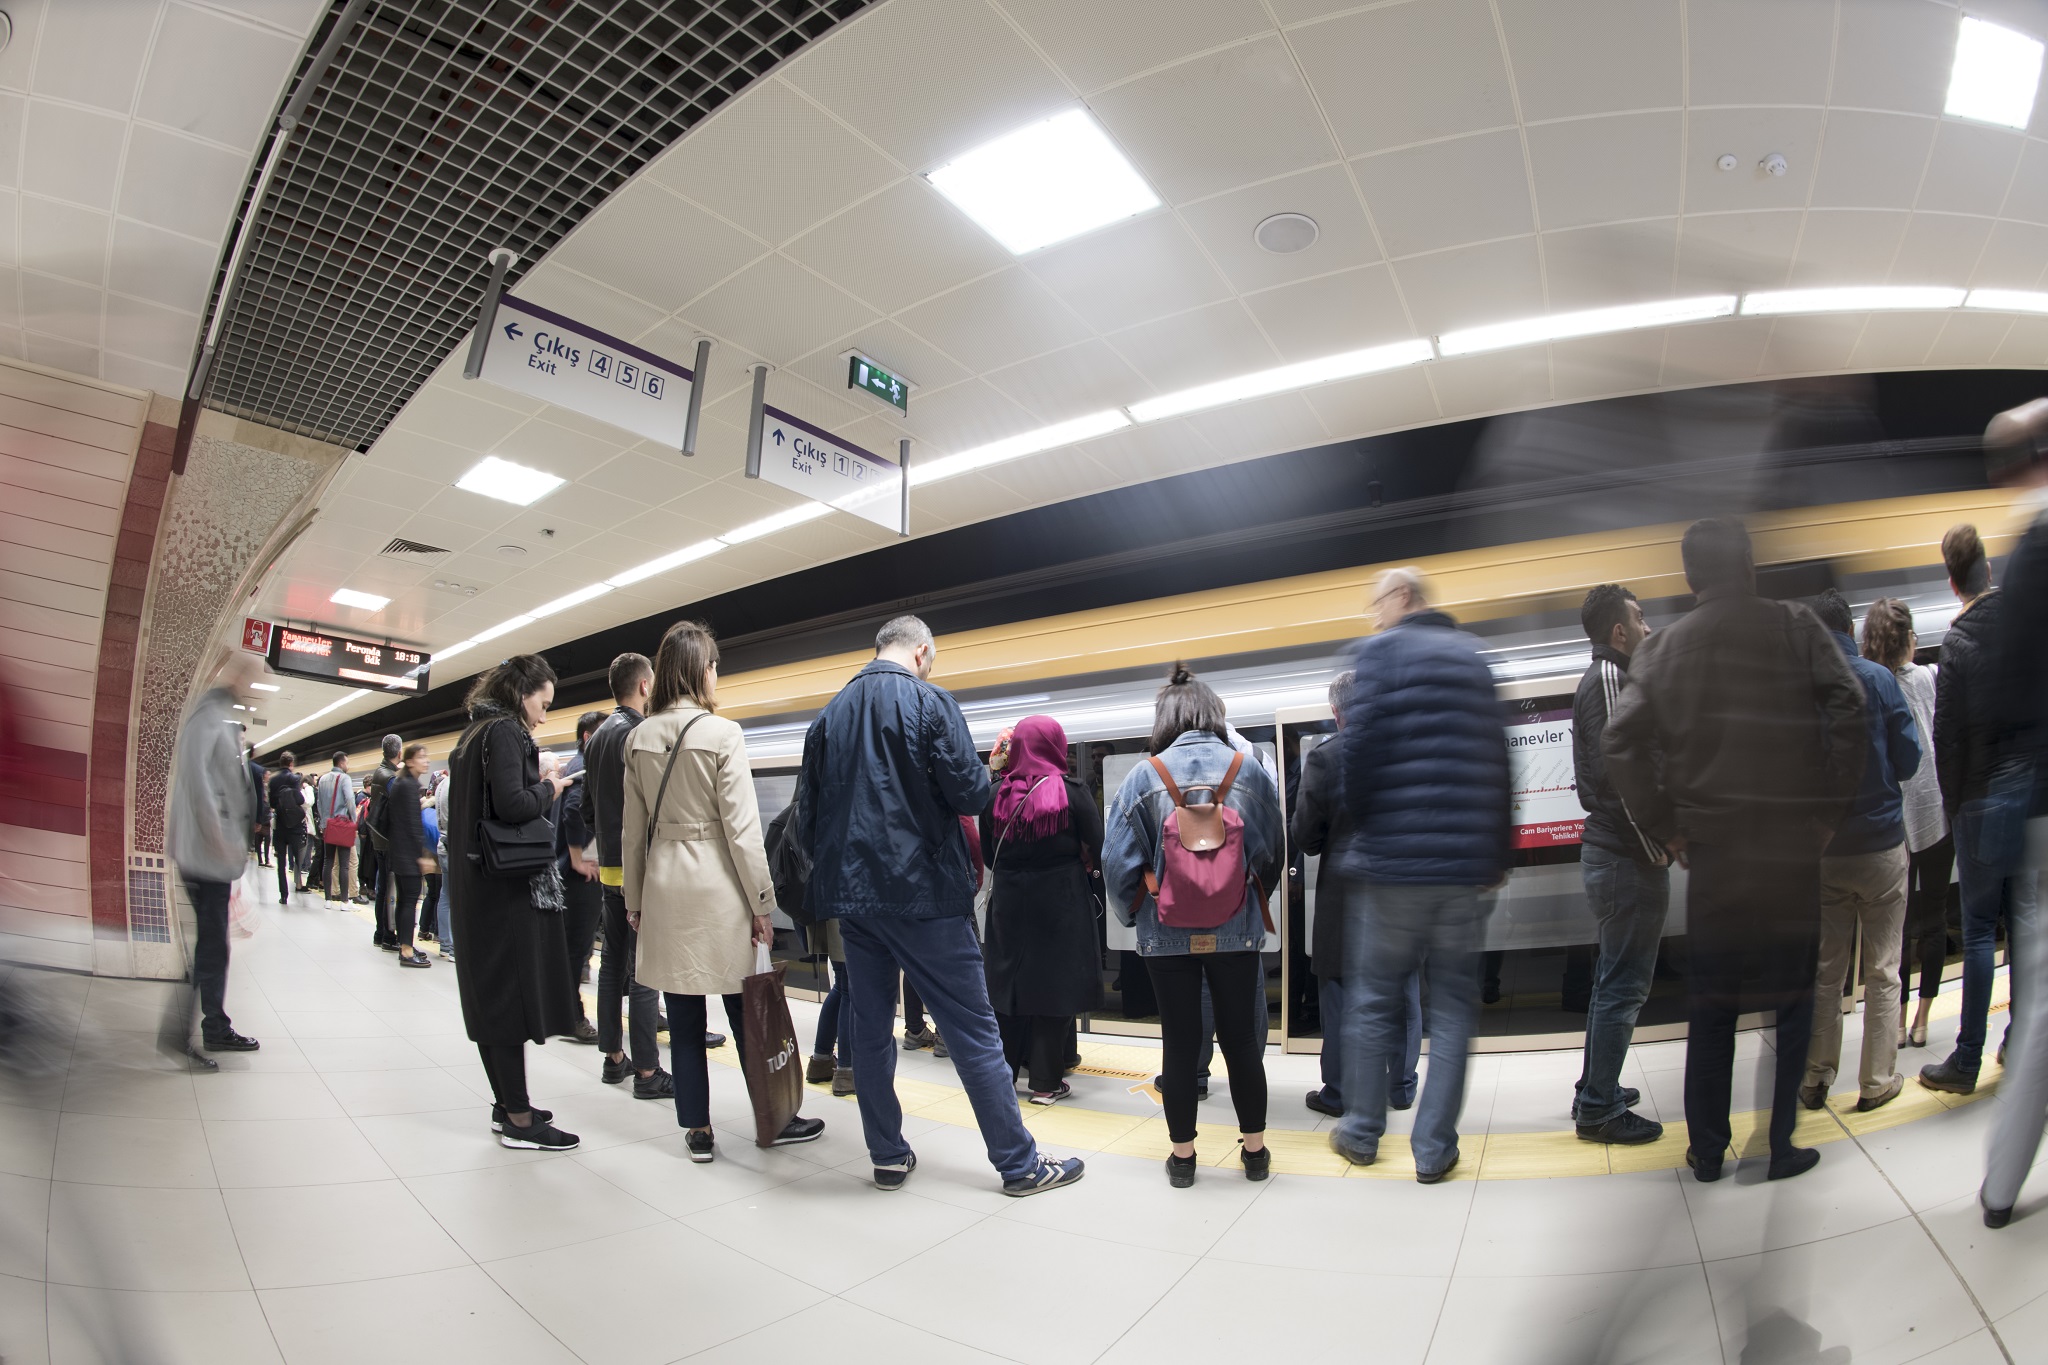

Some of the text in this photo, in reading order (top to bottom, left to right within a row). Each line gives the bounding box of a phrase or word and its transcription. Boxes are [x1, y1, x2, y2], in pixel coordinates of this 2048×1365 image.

[534, 332, 580, 367] Çıkış
[528, 354, 557, 375] Exit
[793, 438, 827, 467] Çıkış
[792, 457, 812, 475] Exit
[346, 642, 381, 656] Peronda
[395, 651, 420, 663] 18:18
[1536, 824, 1573, 834] Bariyerlere
[1551, 831, 1579, 840] Tehlikeli
